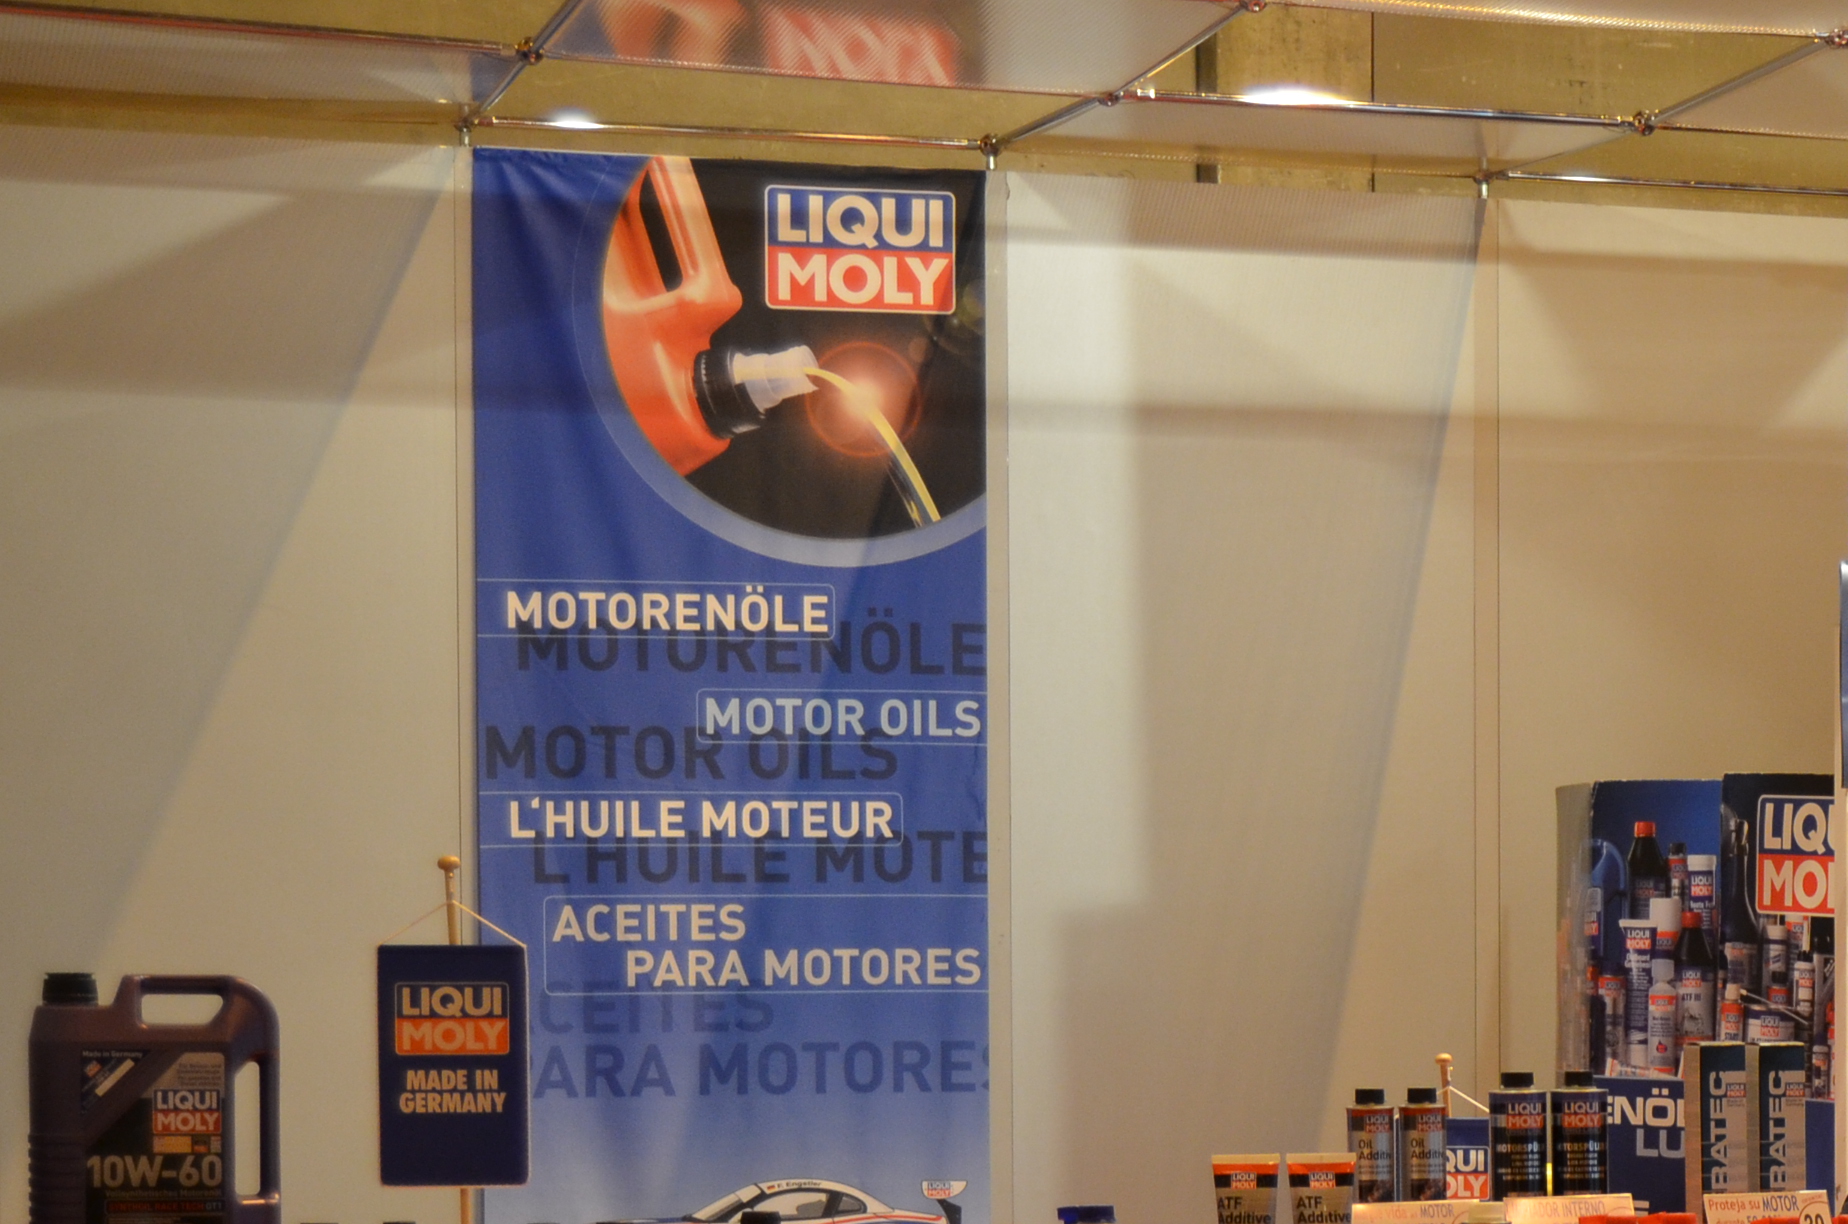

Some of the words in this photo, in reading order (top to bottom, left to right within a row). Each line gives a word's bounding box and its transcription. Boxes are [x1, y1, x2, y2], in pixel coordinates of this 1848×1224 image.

[777, 193, 944, 249] LIQUI
[778, 252, 949, 305] MOLY
[507, 586, 828, 632] MOTORENÖLE
[706, 697, 864, 735] MOTOR
[880, 699, 981, 736] OILS
[510, 797, 685, 838] L'HUILE
[702, 801, 893, 838] MOTEUR
[553, 905, 746, 941] ACEITES
[627, 950, 748, 986] PARA
[765, 950, 981, 986] MOTORES
[402, 986, 502, 1017] LIQUI
[402, 1021, 506, 1050] MOLY
[407, 1070, 467, 1090] MADE
[476, 1070, 498, 1090] IN
[157, 1091, 217, 1110] LIQUI
[400, 1092, 506, 1113] GERMANY
[1564, 1102, 1598, 1114] LIQUI
[157, 1113, 218, 1131] MOLY
[1564, 1114, 1600, 1127] MOLY
[87, 1155, 222, 1187] 10W-60
[1297, 1196, 1322, 1209] ATF
[1708, 1199, 1747, 1214] Proteja
[1749, 1201, 1761, 1211] su
[1762, 1195, 1800, 1212] MOTOR
[1298, 1211, 1350, 1224] Additive
